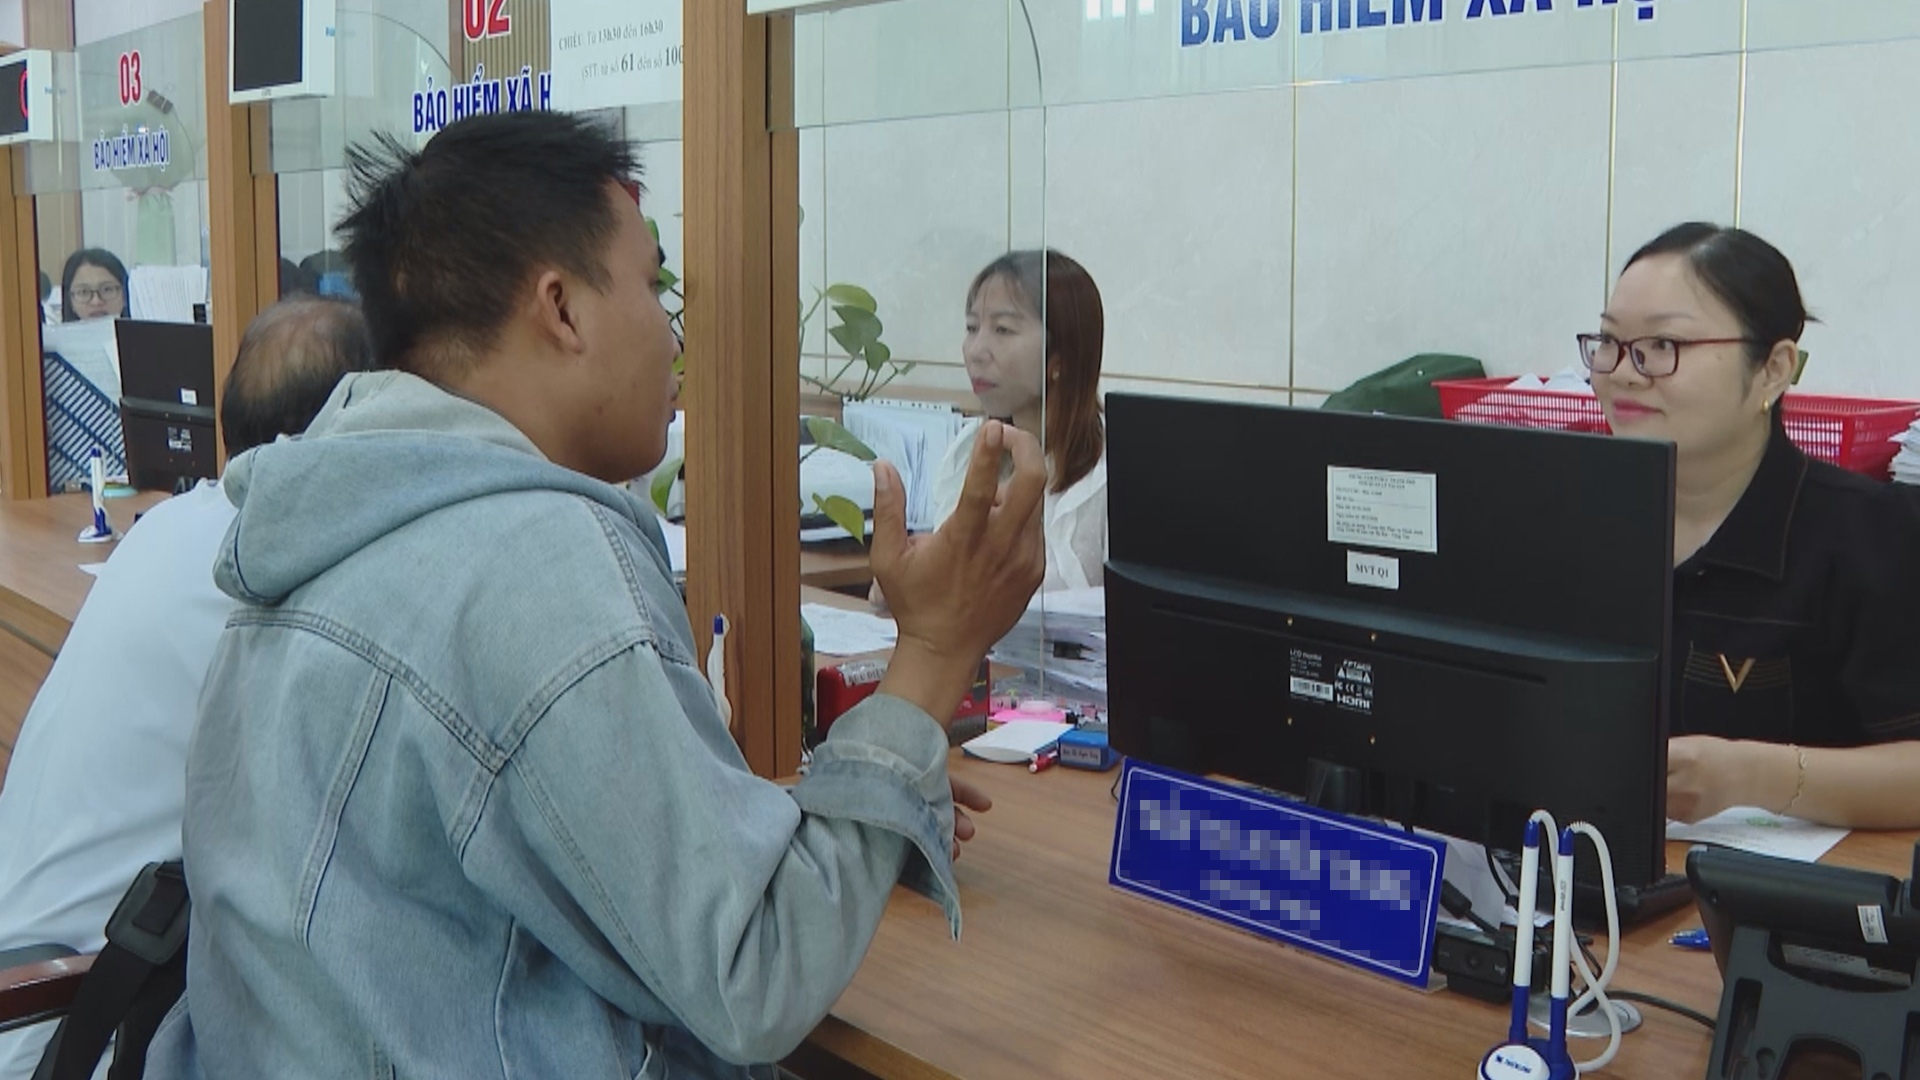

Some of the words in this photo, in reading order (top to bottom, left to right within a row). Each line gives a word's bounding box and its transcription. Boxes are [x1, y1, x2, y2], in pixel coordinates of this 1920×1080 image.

[599, 26, 621, 43] 13h30
[640, 19, 663, 37] 16h30
[621, 52, 634, 73] 61
[120, 51, 141, 106] 03
[413, 76, 447, 132] BẢO
[453, 65, 500, 122] HIỂM
[507, 67, 532, 113] XÃ
[1355, 562, 1375, 576] MVT
